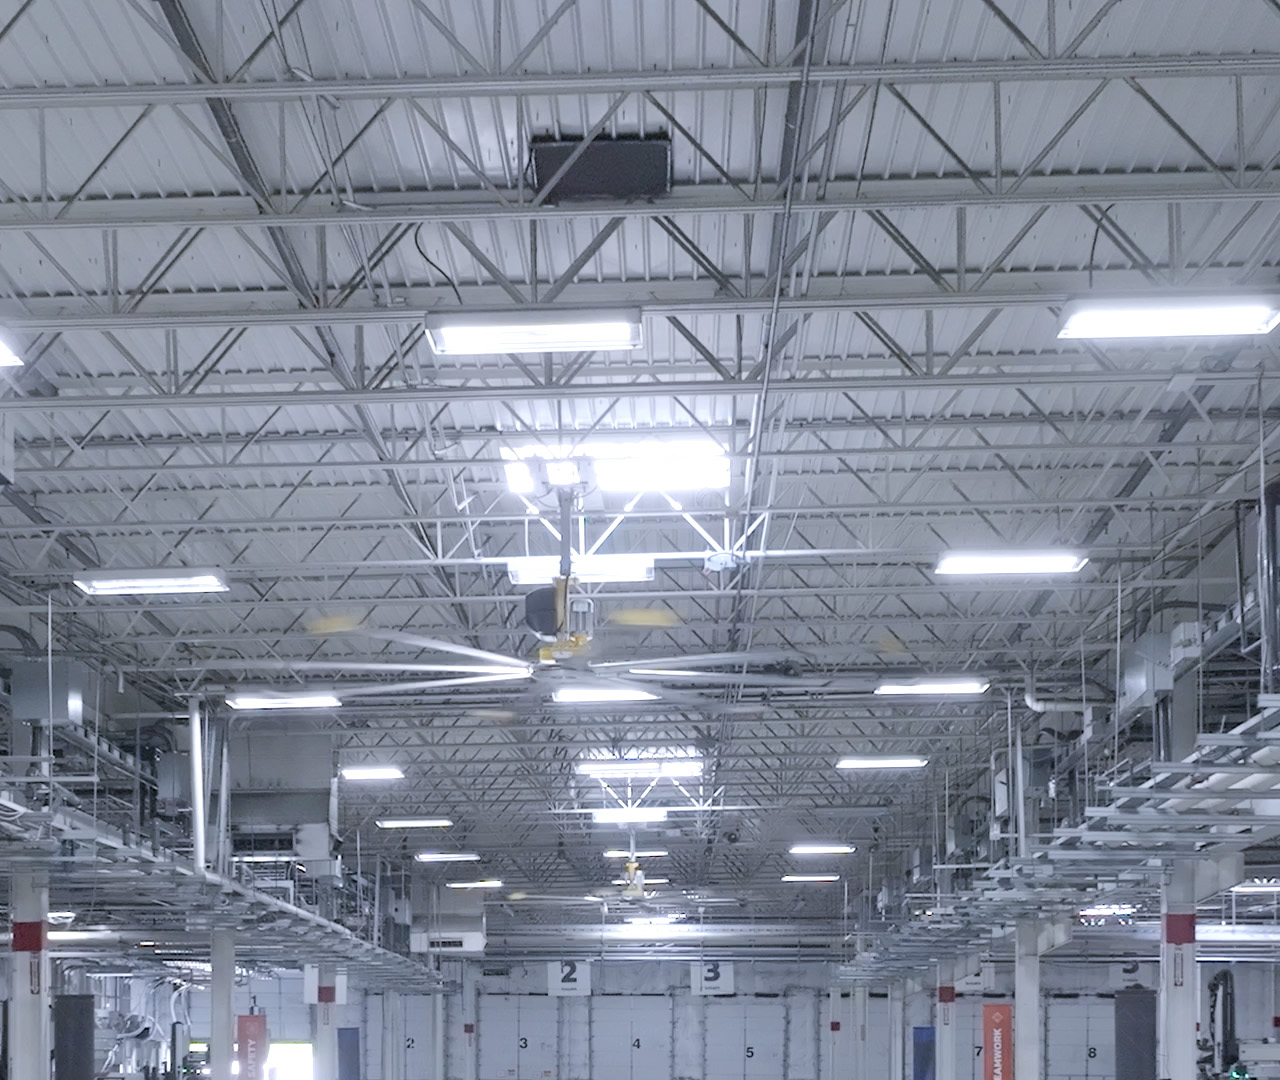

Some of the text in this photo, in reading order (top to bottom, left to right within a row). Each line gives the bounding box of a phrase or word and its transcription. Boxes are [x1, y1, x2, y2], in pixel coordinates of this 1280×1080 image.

[561, 961, 578, 983] 2
[703, 962, 721, 982] 3
[406, 1038, 415, 1049] 2
[519, 1037, 528, 1049] 3
[632, 1038, 641, 1049] 4
[745, 1047, 754, 1058] 5
[974, 1046, 983, 1057] 7
[1088, 1047, 1097, 1058] 8
[247, 1039, 257, 1078] SAFETY
